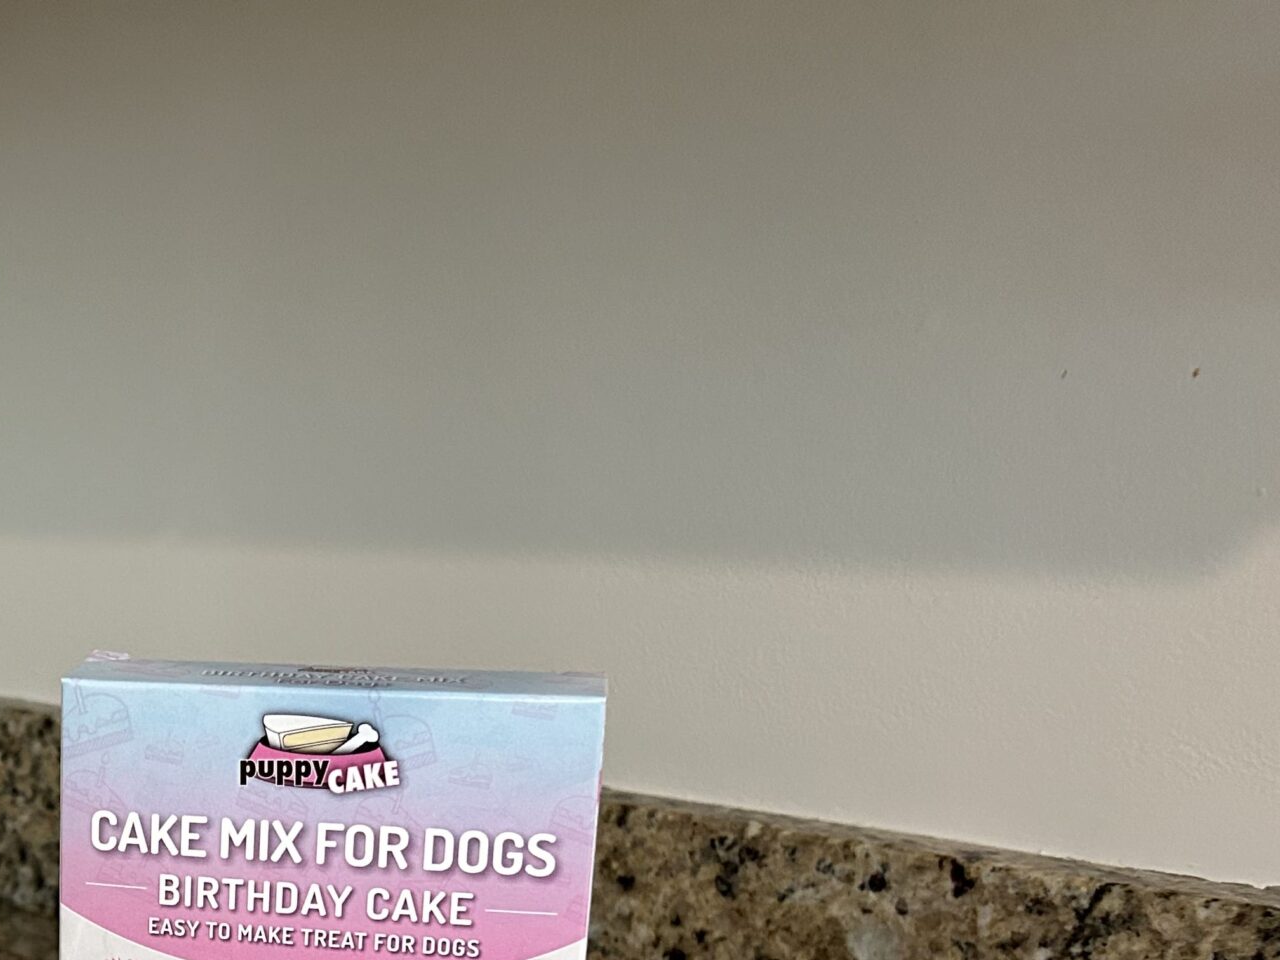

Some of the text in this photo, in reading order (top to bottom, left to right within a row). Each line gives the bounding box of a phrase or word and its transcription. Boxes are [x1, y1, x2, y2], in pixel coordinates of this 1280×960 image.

[90, 809, 558, 878] CAKE MIX FOR DOGS
[158, 873, 475, 926] BIRTHDAY CAKE
[148, 916, 481, 958] EASY TO MAKE TREAT FOR DOGS
